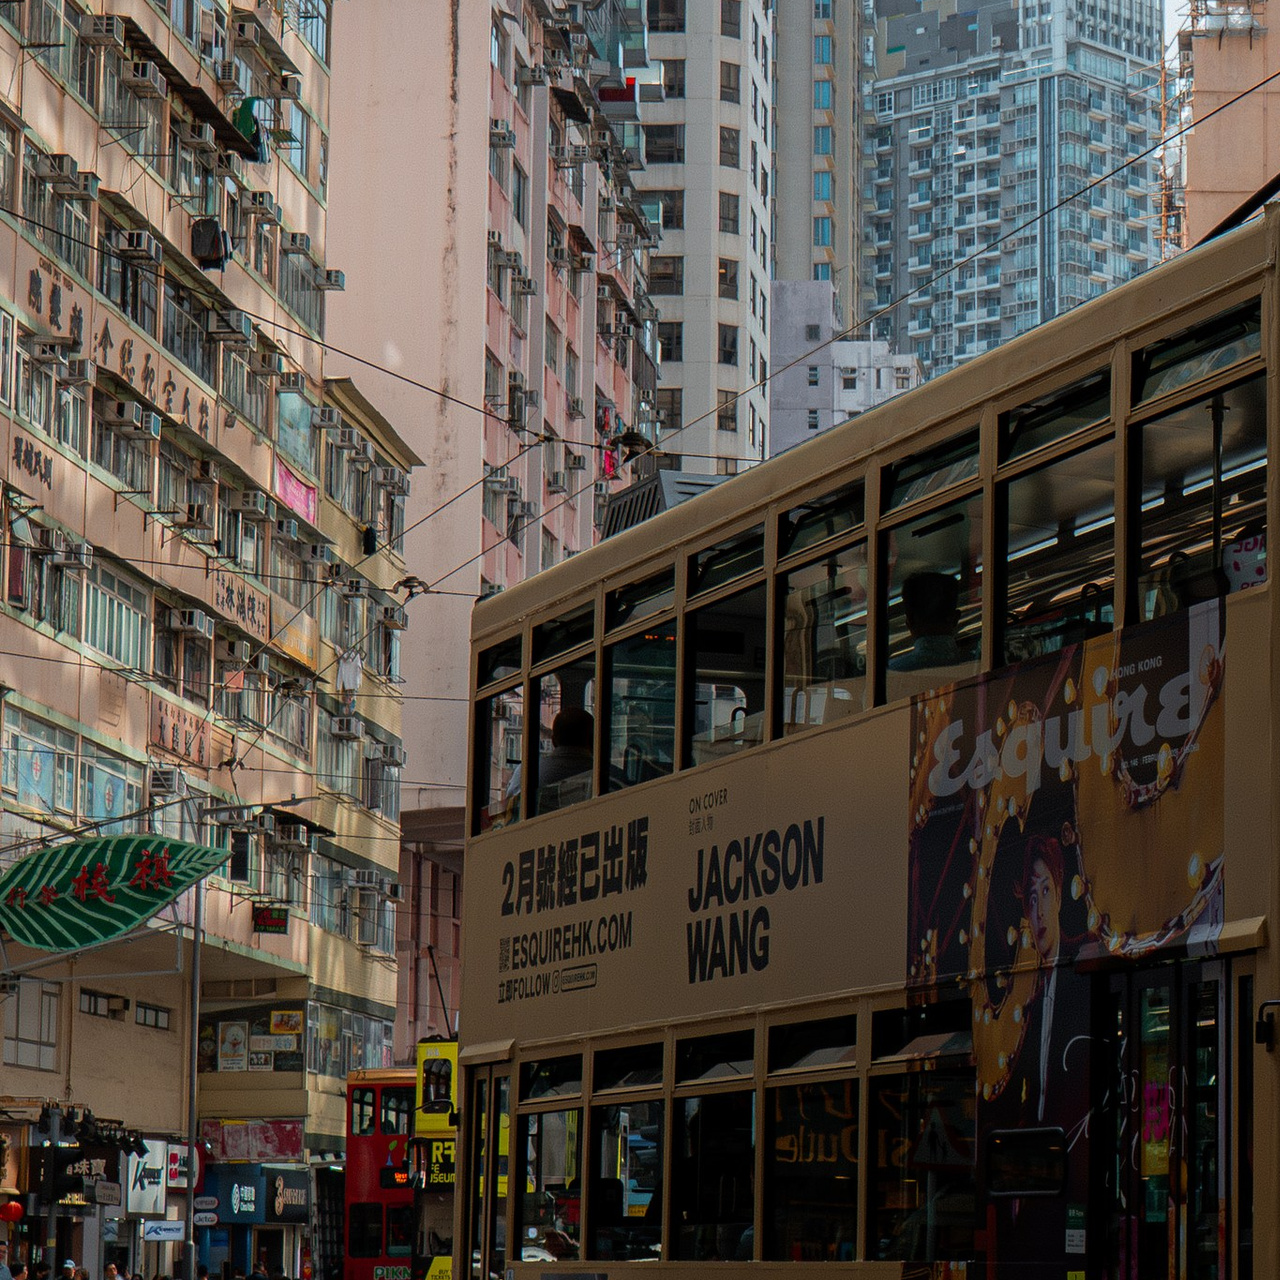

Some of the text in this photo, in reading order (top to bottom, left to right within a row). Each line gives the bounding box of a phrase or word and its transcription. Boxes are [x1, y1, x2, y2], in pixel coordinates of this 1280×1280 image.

[1138, 656, 1162, 676] KONG
[928, 670, 1197, 797] Esquire
[688, 814, 715, 837] 封面人物
[689, 787, 728, 815] ON COVER
[501, 816, 650, 917] 2月號經已出版
[687, 816, 826, 913] JACKSON
[512, 911, 634, 971] ESQUIREHK.COM
[686, 905, 771, 985] WANG
